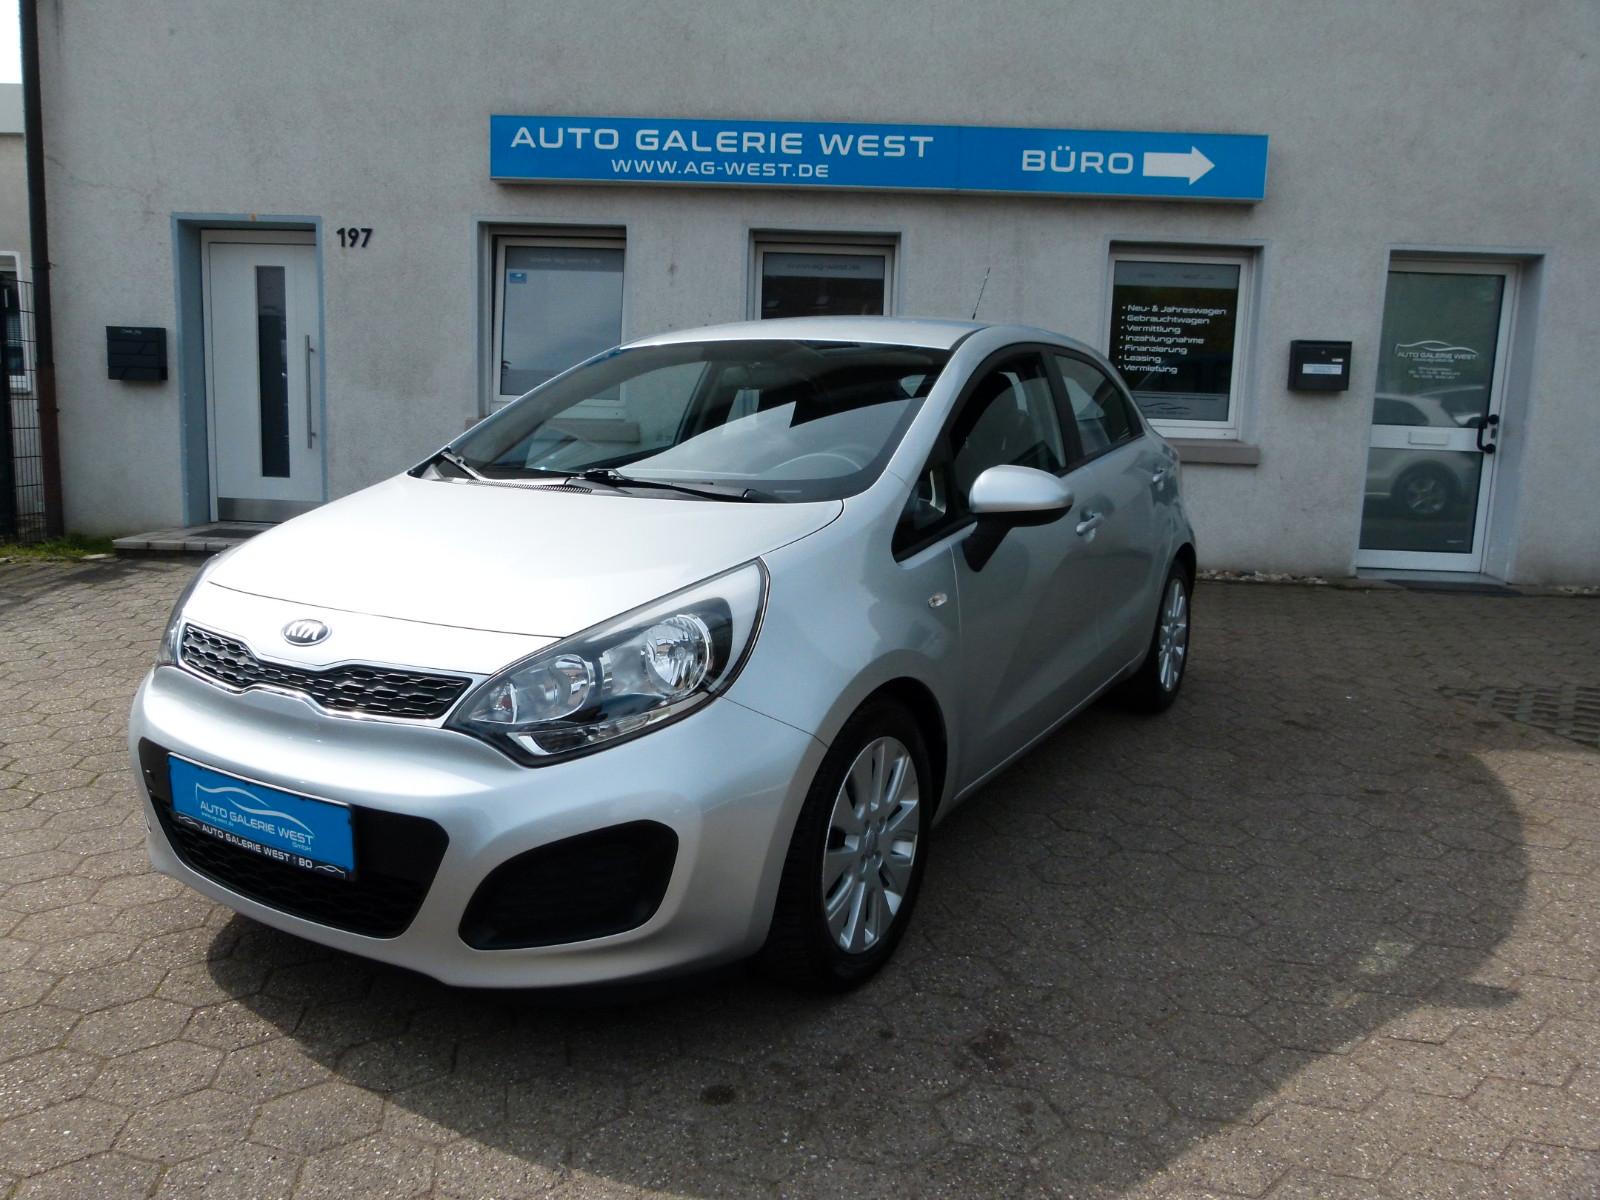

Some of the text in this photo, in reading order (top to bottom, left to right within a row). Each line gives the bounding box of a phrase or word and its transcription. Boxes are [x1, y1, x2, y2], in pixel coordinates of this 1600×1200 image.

[510, 126, 935, 158] AUTO GALERIE WEST
[1021, 145, 1134, 174] BÜRO
[611, 158, 830, 179] WWW.AG-WEST.DE
[336, 227, 373, 248] 197
[1127, 304, 1150, 313] Neu-
[1160, 306, 1227, 316] Jahreswagen
[1126, 314, 1210, 325] Gebrauchtwagen
[1126, 324, 1181, 335] Vermittlung
[1125, 334, 1204, 345] Inzahlungnahme
[1124, 344, 1188, 355] Finanzierung
[1123, 354, 1162, 364] Leasing
[1123, 364, 1178, 374] Vermietung
[284, 620, 323, 641] KIA
[200, 800, 313, 846] AUTO GALERIE WEST
[202, 823, 224, 840] AUTO
[225, 833, 261, 853] GALERIE
[262, 846, 290, 862] WEST
